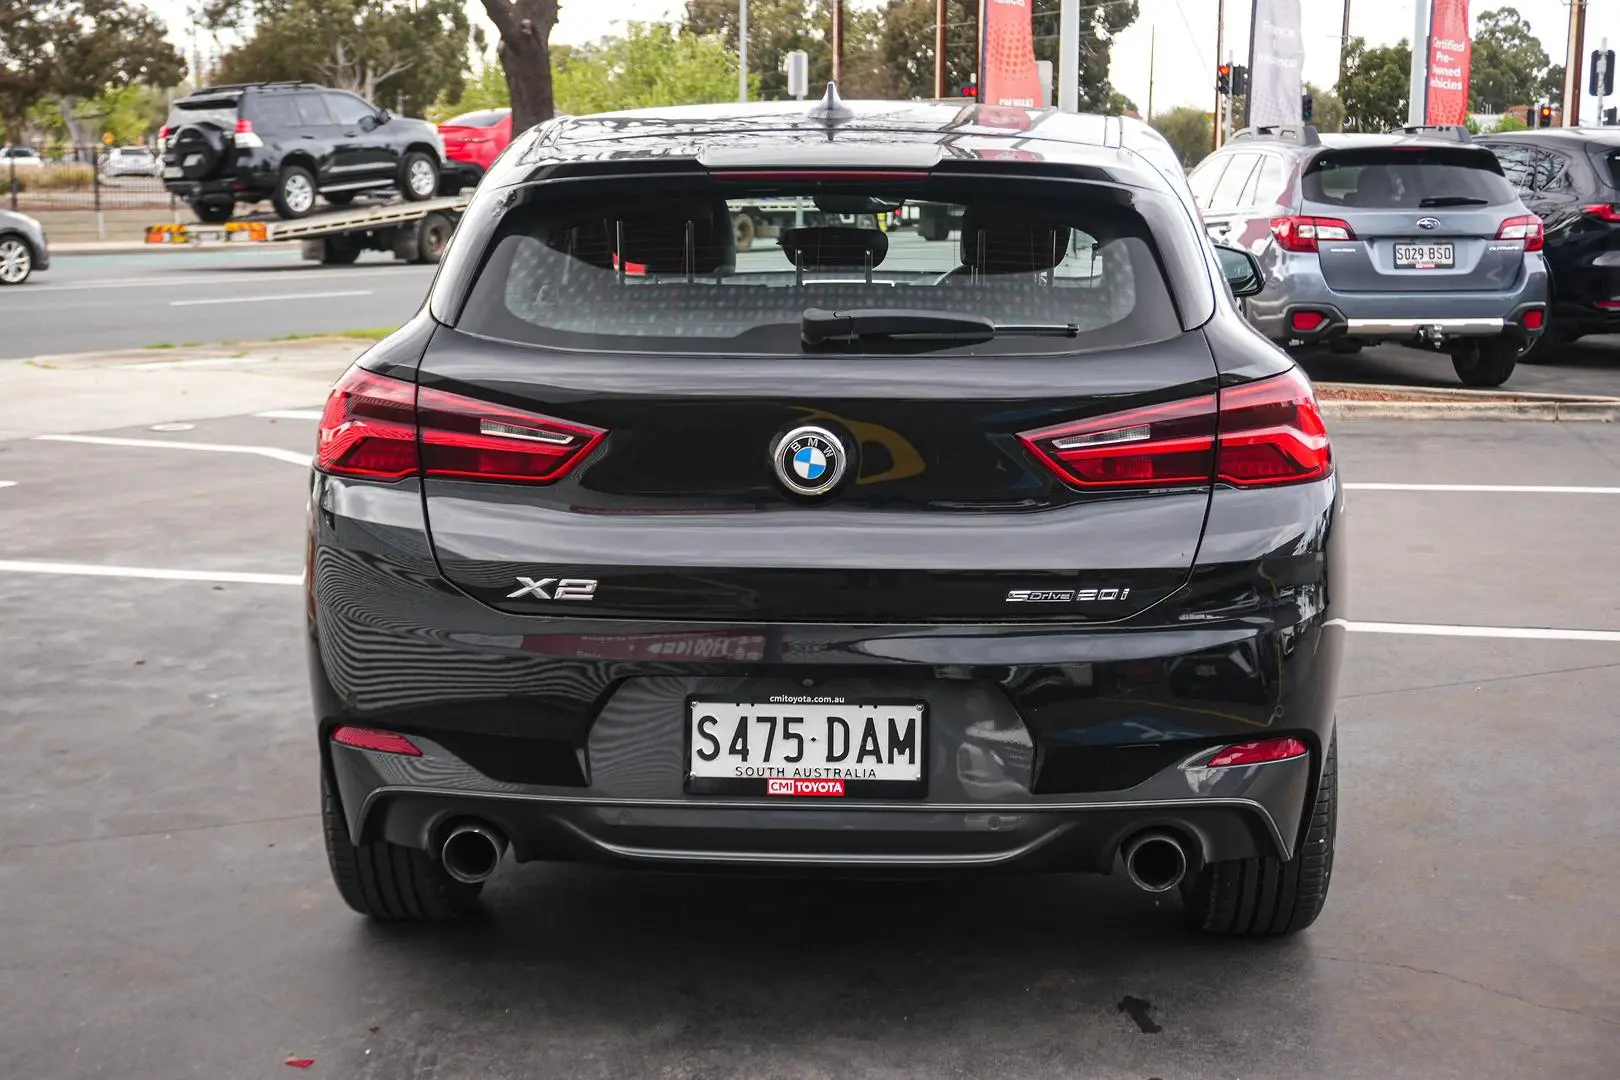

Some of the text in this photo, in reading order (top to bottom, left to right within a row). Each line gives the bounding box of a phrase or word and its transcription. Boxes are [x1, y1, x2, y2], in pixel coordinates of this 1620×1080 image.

[1430, 77, 1463, 90] ehicles
[790, 438, 834, 458] BMW
[506, 576, 598, 601] X2
[769, 694, 845, 704] cmitoyota.com.au
[735, 766, 878, 779] SOUTH AUSTRALIA
[770, 781, 843, 793] CMI TOYOTA
